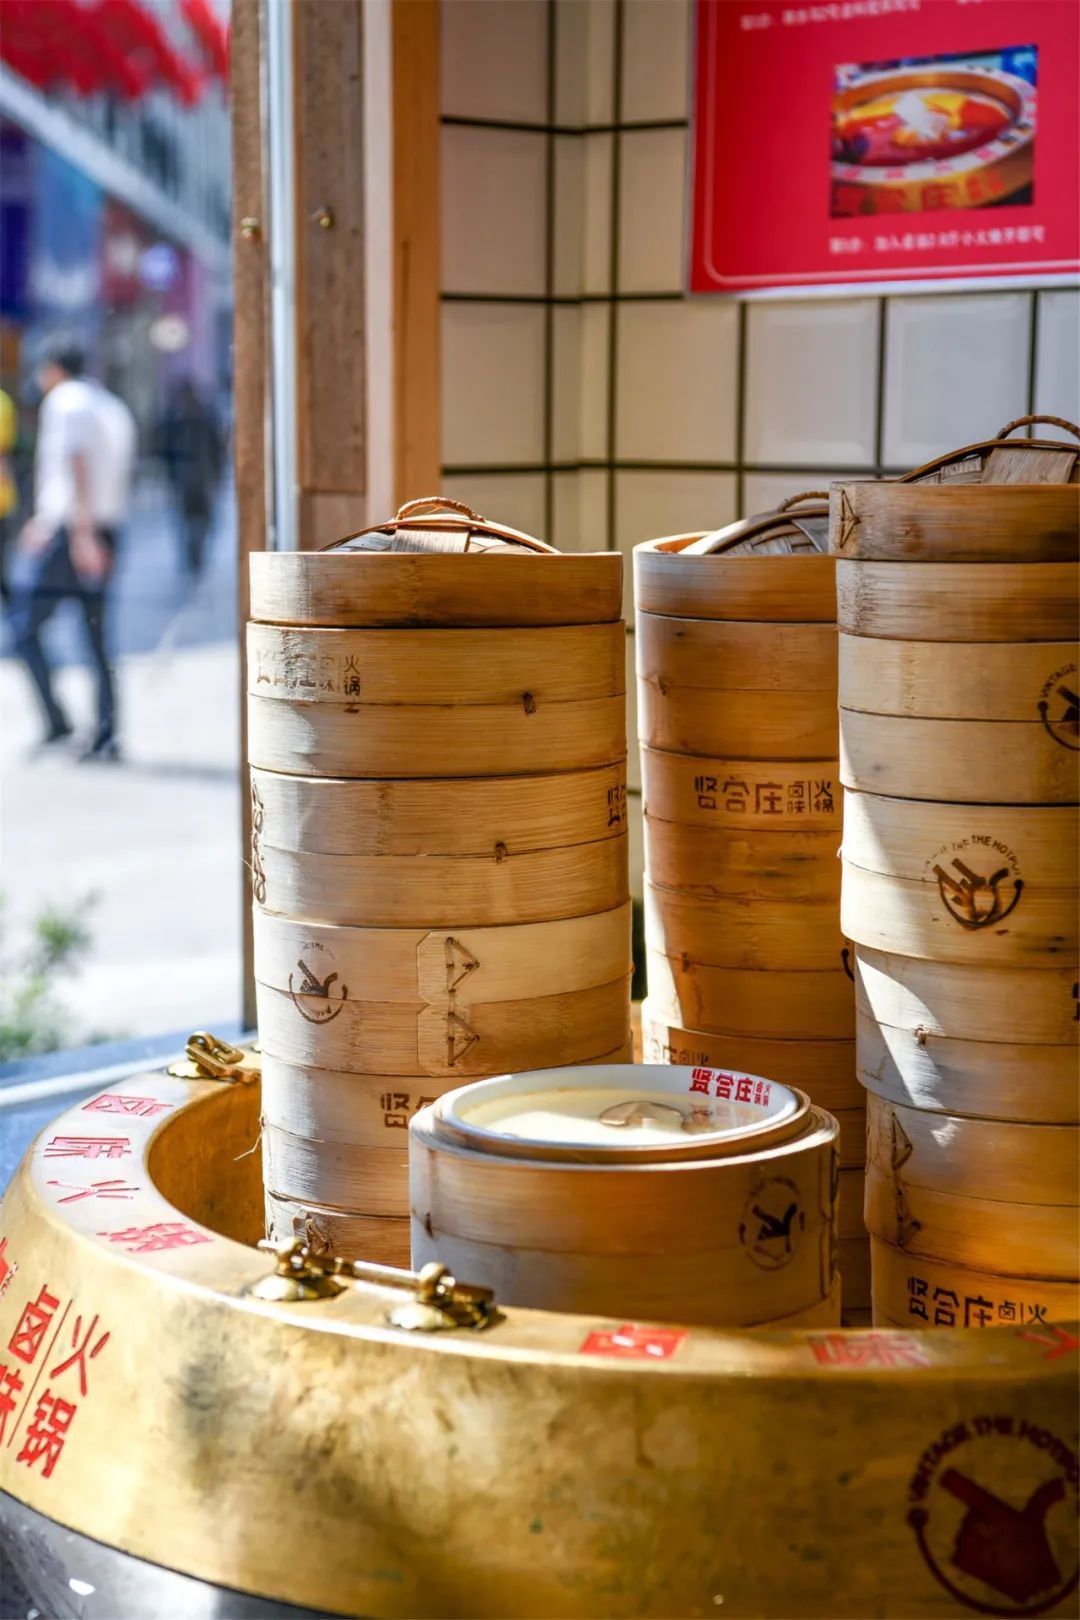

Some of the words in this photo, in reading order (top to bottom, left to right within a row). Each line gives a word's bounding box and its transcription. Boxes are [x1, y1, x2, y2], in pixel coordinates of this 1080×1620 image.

[972, 835, 992, 846] THE
[909, 1421, 973, 1502] VINTAGE
[972, 1415, 1014, 1437] THE
[1019, 1418, 1080, 1498] HOTPO
